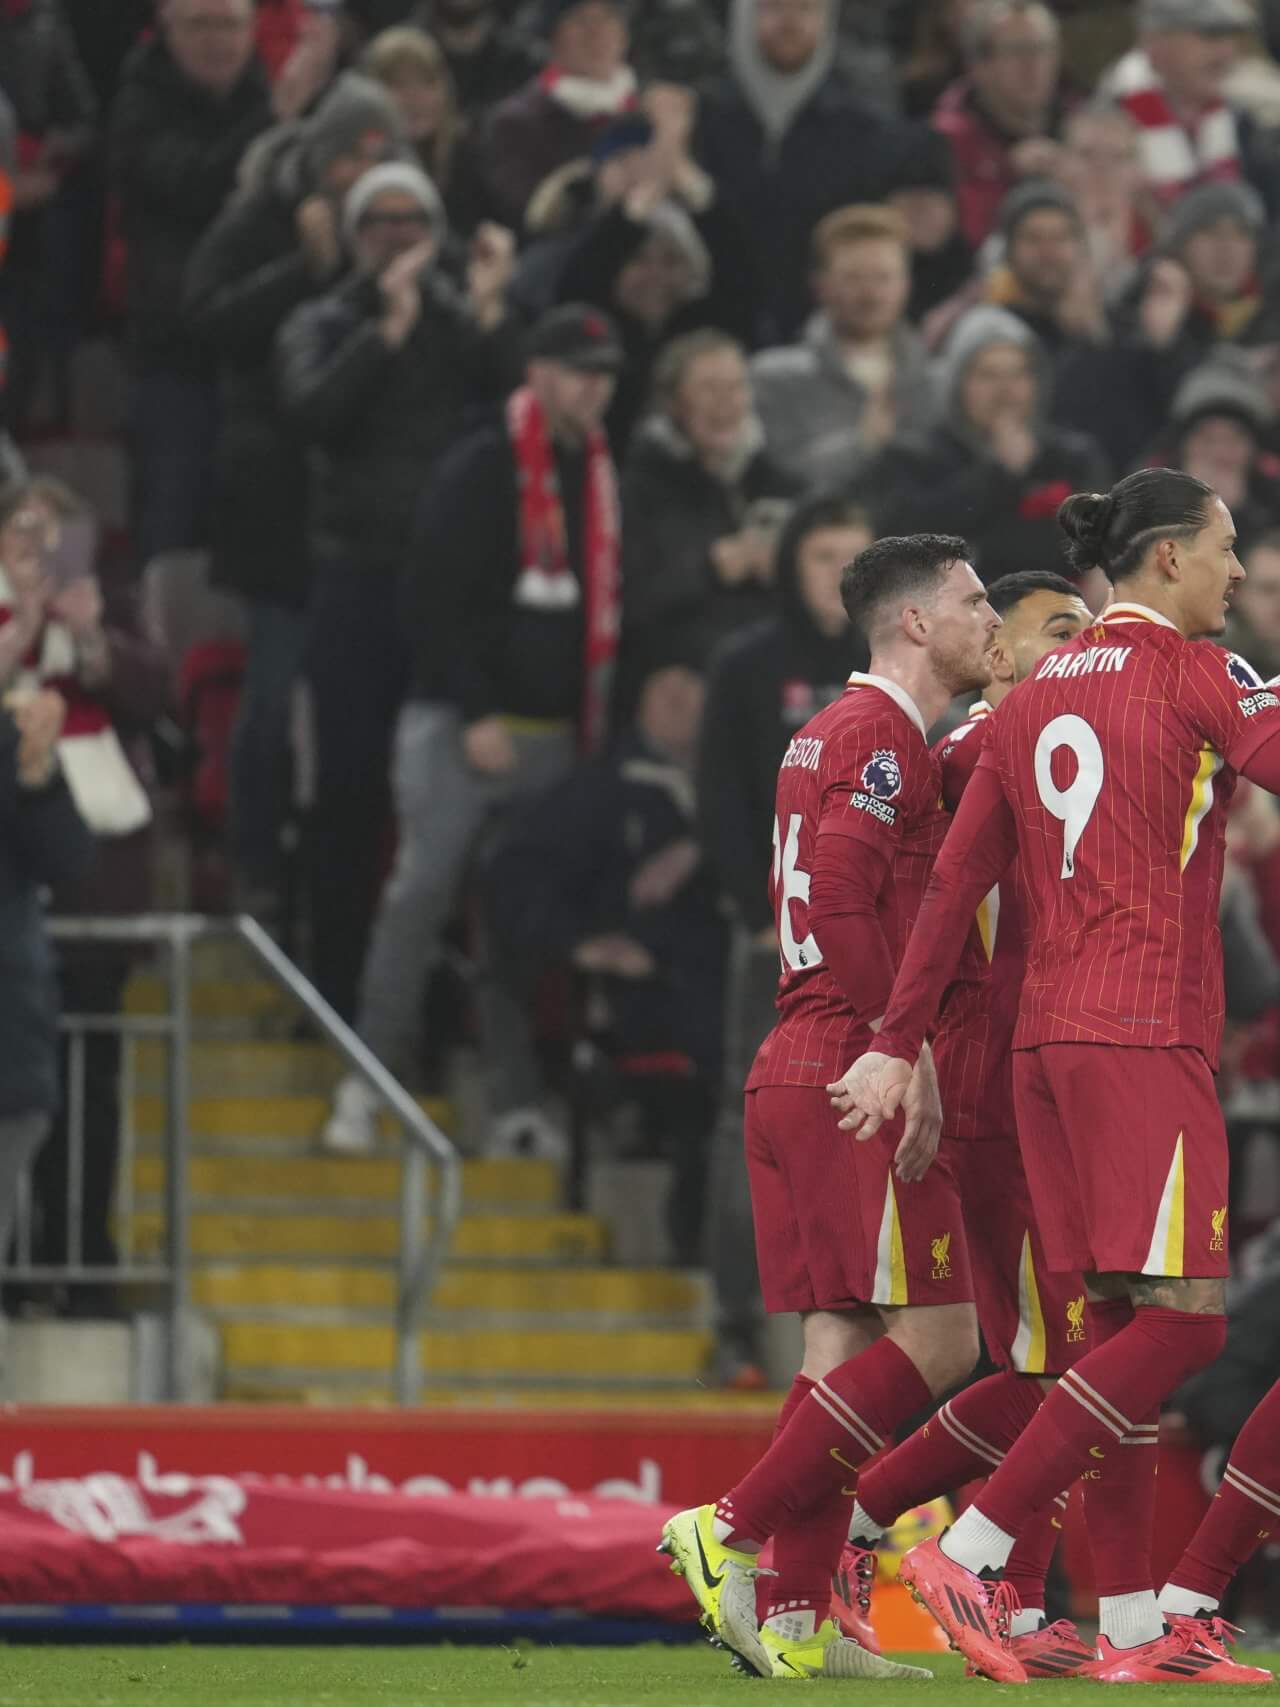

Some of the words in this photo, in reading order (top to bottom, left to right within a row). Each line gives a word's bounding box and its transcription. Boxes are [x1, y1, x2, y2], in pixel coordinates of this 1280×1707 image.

[1034, 646, 1133, 681] DARWIN
[1034, 713, 1104, 880] 9
[772, 813, 824, 974] 6
[931, 1268, 952, 1280] LFC
[1066, 1331, 1086, 1343] LFC
